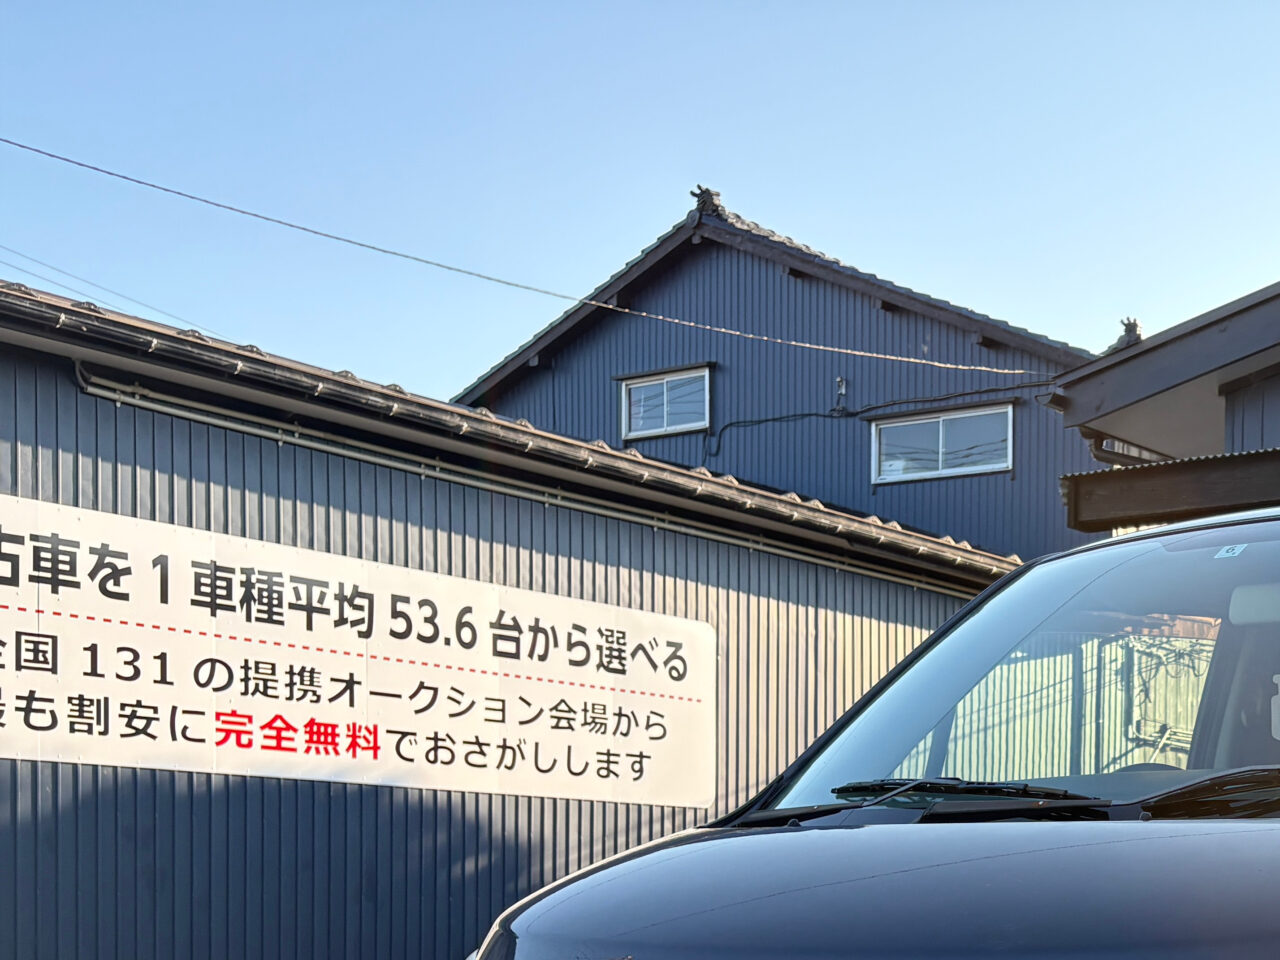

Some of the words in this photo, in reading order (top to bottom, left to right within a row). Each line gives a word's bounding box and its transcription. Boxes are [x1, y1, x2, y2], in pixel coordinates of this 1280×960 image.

[0, 630, 667, 741] 国131の提携オークション会場から
[0, 687, 651, 781] も割安に完全無料でおさがしします
